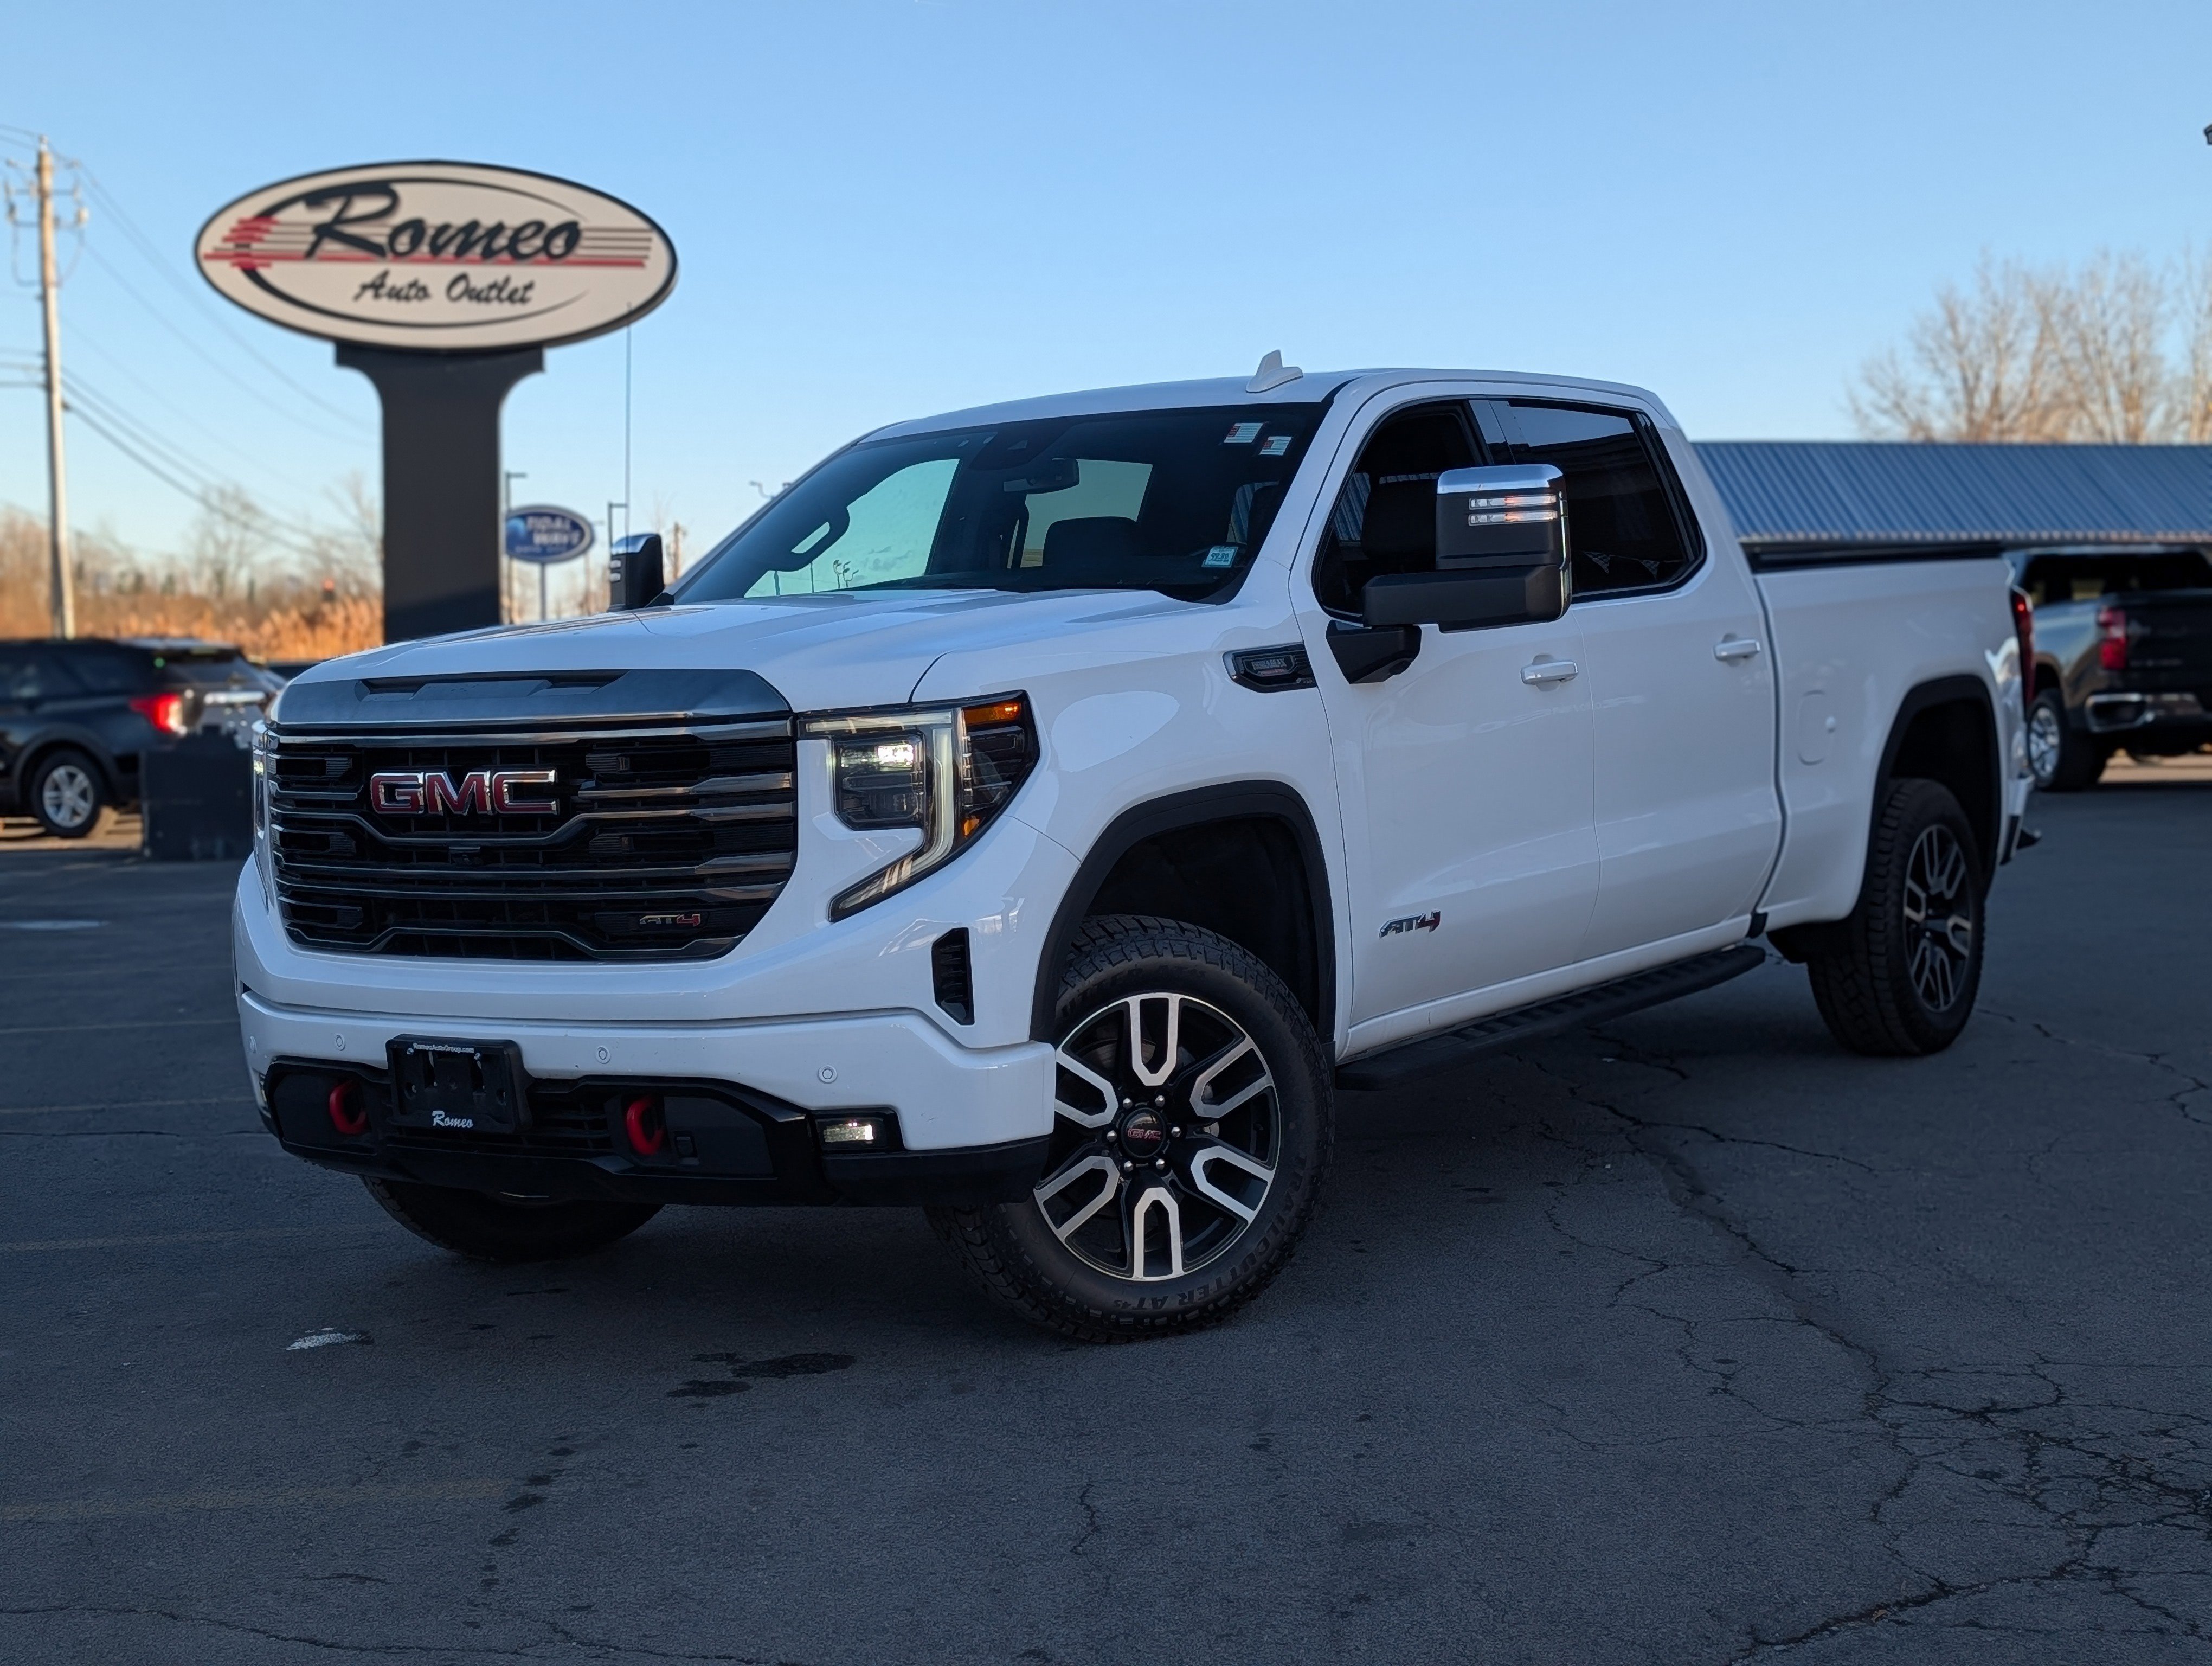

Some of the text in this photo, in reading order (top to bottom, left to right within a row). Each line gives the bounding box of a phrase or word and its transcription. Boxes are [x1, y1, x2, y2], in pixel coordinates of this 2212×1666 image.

[304, 182, 582, 260] Romeo
[353, 268, 535, 304] Auto Outlet
[370, 769, 560, 815] GMC
[639, 913, 700, 927] AT4
[1379, 909, 1441, 938] AT4
[432, 1110, 474, 1129] Romeo
[1127, 1127, 1161, 1140] GMC
